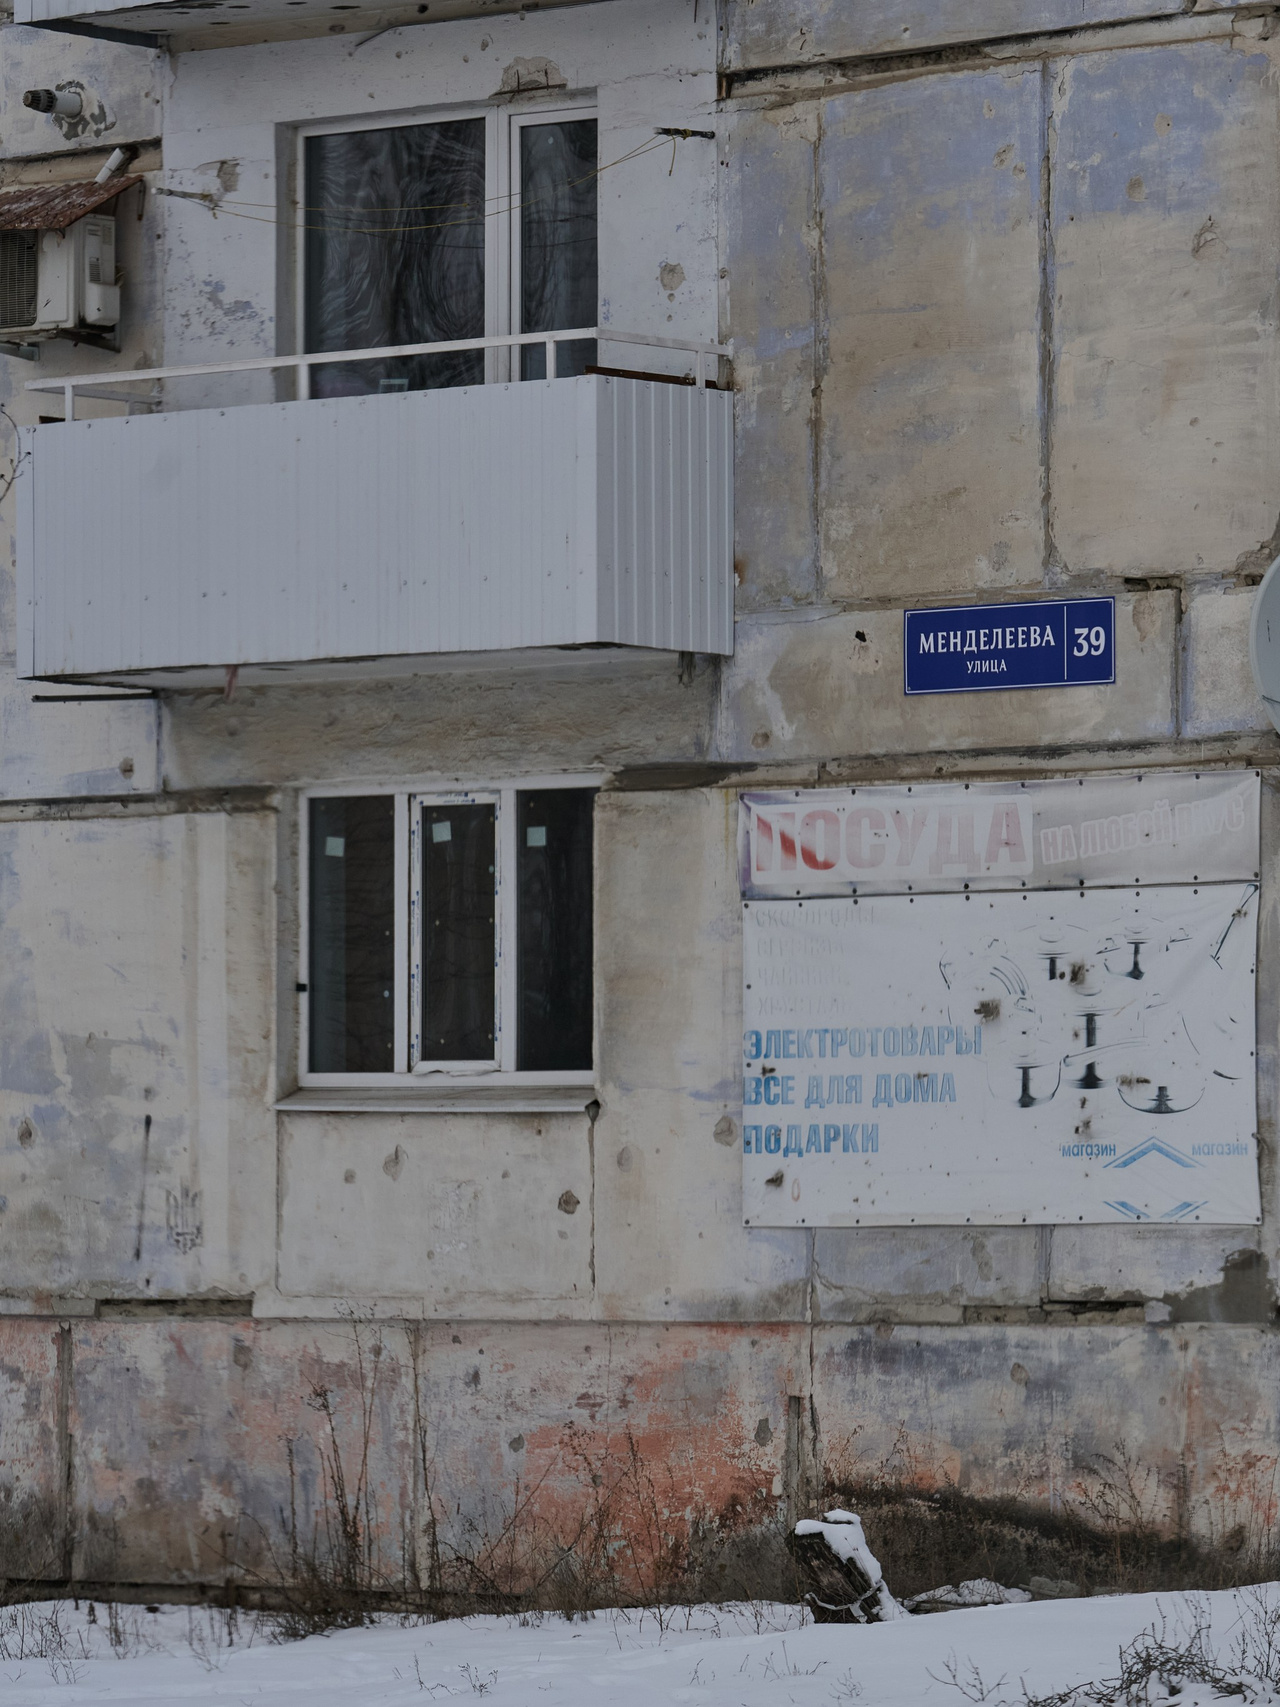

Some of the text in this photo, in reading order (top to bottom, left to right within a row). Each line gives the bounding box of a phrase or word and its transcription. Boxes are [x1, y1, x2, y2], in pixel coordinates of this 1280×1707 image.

[918, 625, 1106, 657] МЕНДЕЛЕЕВА 39
[966, 659, 1008, 674] УЛИЦА
[755, 801, 1026, 876] ПОСУДА
[1040, 825, 1077, 865] НА
[1080, 799, 1172, 859] ЛЮБОЙ
[743, 1025, 983, 1060] ЭЛЕКТРОТОВАРЫ
[743, 1072, 958, 1109] ВСЕ ДЛЯ ДОМА
[743, 1123, 880, 1158] ПОДАРКИ
[1061, 1143, 1116, 1158] магазин
[1191, 1142, 1249, 1156] магазин
